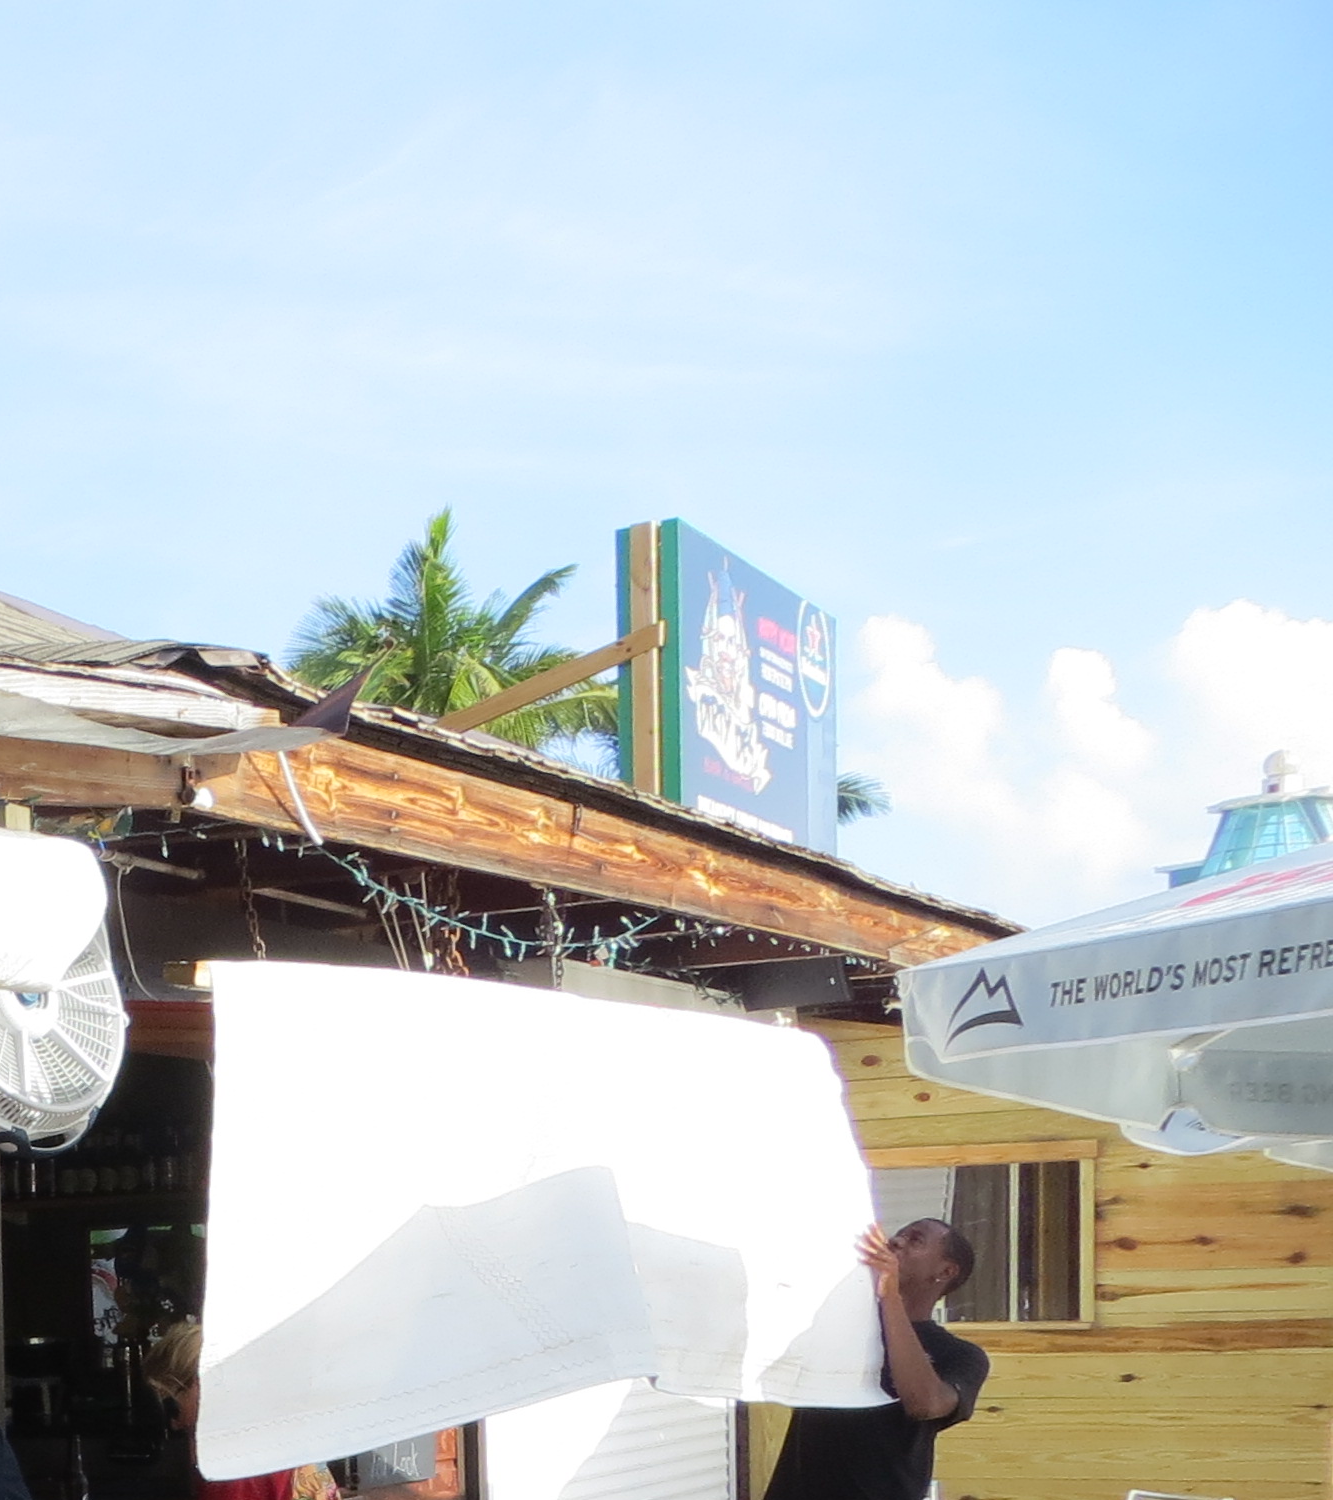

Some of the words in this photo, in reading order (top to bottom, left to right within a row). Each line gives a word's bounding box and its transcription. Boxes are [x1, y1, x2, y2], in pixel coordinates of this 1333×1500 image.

[1050, 978, 1087, 1007] THE
[1094, 964, 1186, 1001] WORLD'S
[1192, 952, 1252, 988] MOST
